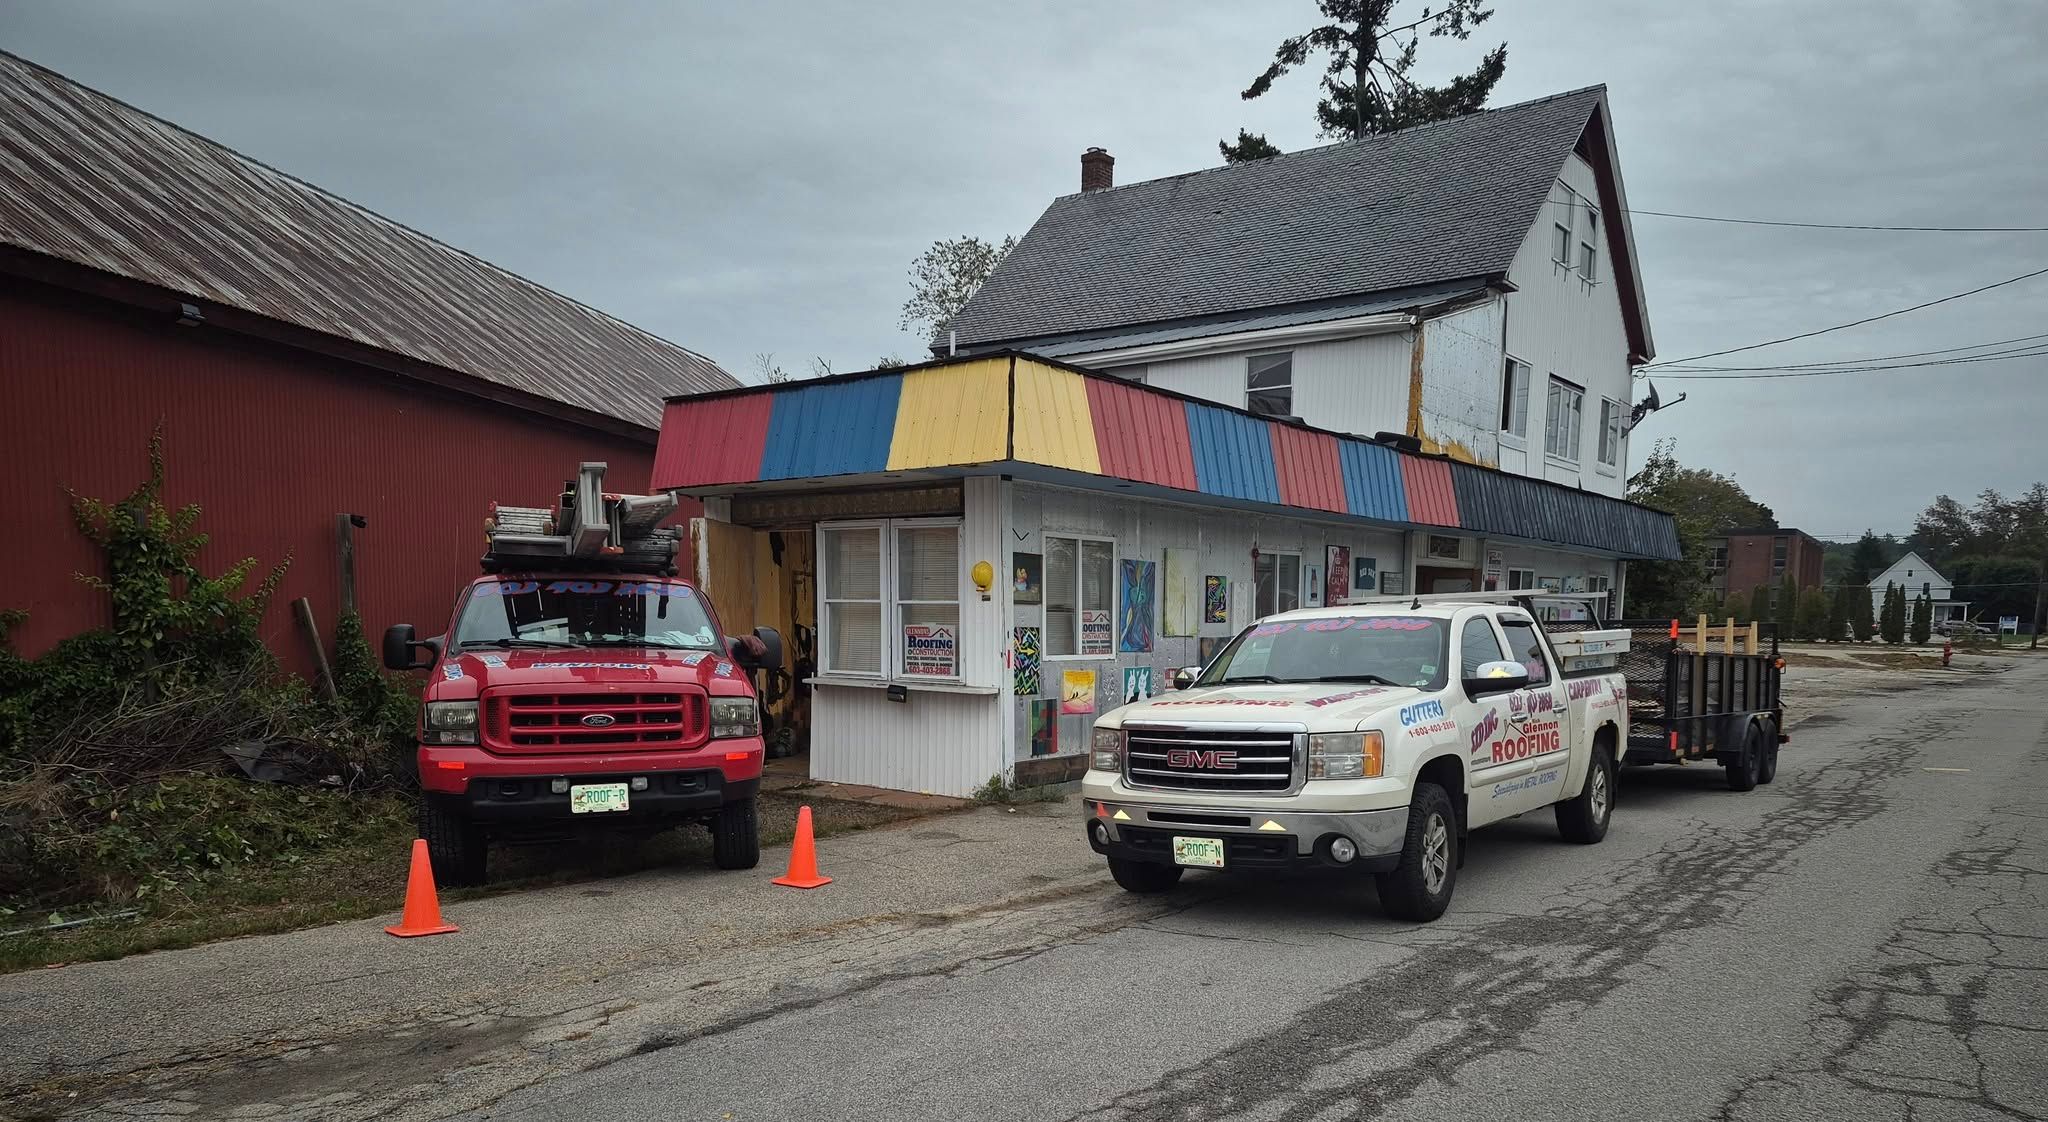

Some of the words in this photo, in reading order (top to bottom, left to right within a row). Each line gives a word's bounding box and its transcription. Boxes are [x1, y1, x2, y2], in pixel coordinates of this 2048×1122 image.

[908, 636, 953, 649] ROOFING
[912, 649, 954, 657] CONSTRUCTION
[1568, 679, 1602, 701] CARPENTRY
[1151, 699, 1294, 708] ROOFING
[1400, 699, 1444, 727] GUTTERS
[1471, 707, 1499, 756] SIDING
[1522, 720, 1559, 734] Glennon
[1492, 730, 1560, 764] ROOFING
[1166, 749, 1238, 770] GMC
[585, 788, 626, 803] ROOF-R
[1186, 843, 1221, 858] ROOF-N
